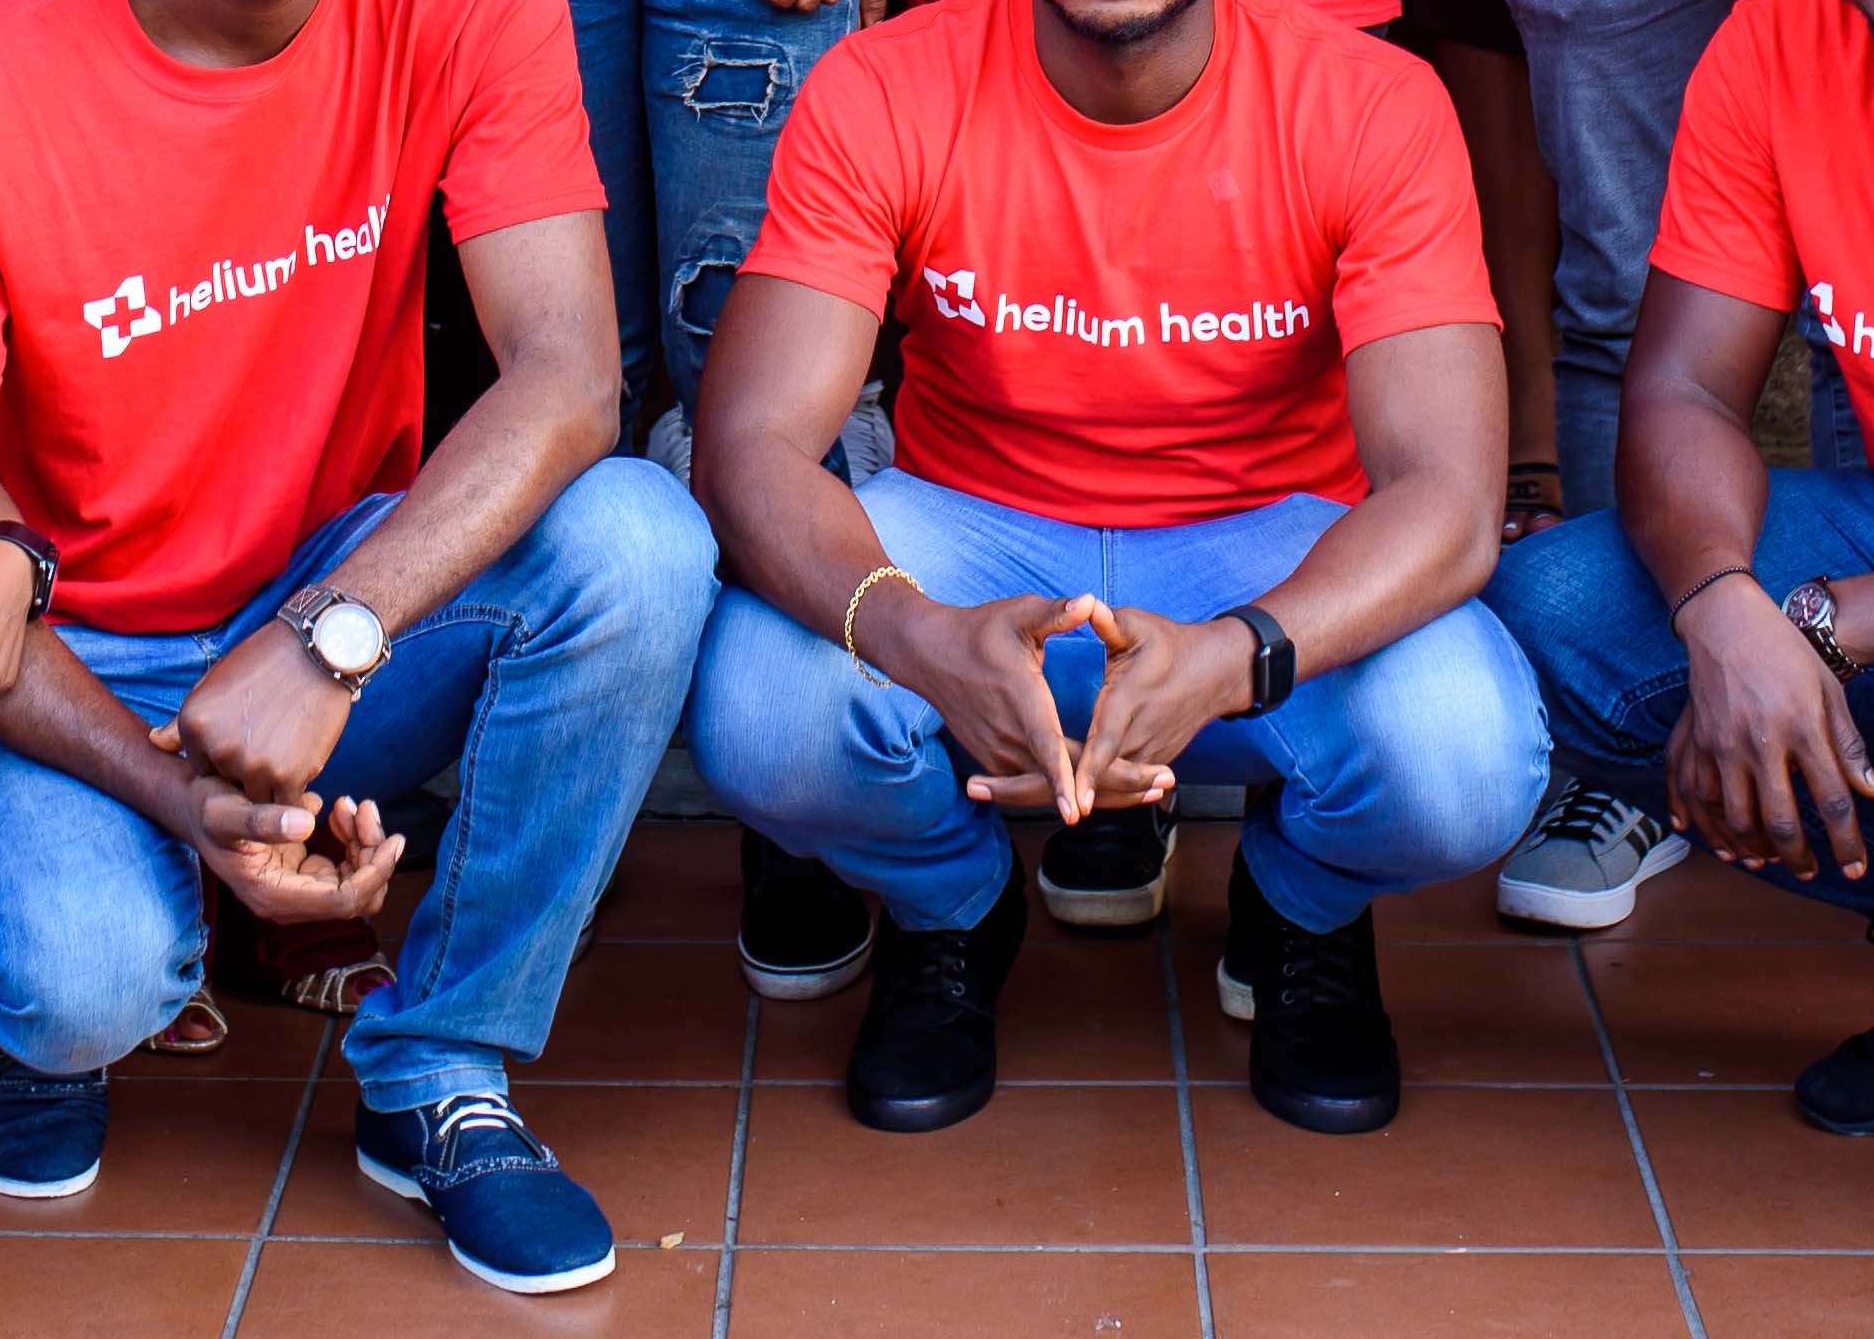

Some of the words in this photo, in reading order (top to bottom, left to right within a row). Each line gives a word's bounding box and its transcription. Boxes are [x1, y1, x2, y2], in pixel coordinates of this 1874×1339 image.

[168, 250, 298, 327] helium
[994, 292, 1146, 348] helium
[1159, 300, 1310, 344] health
